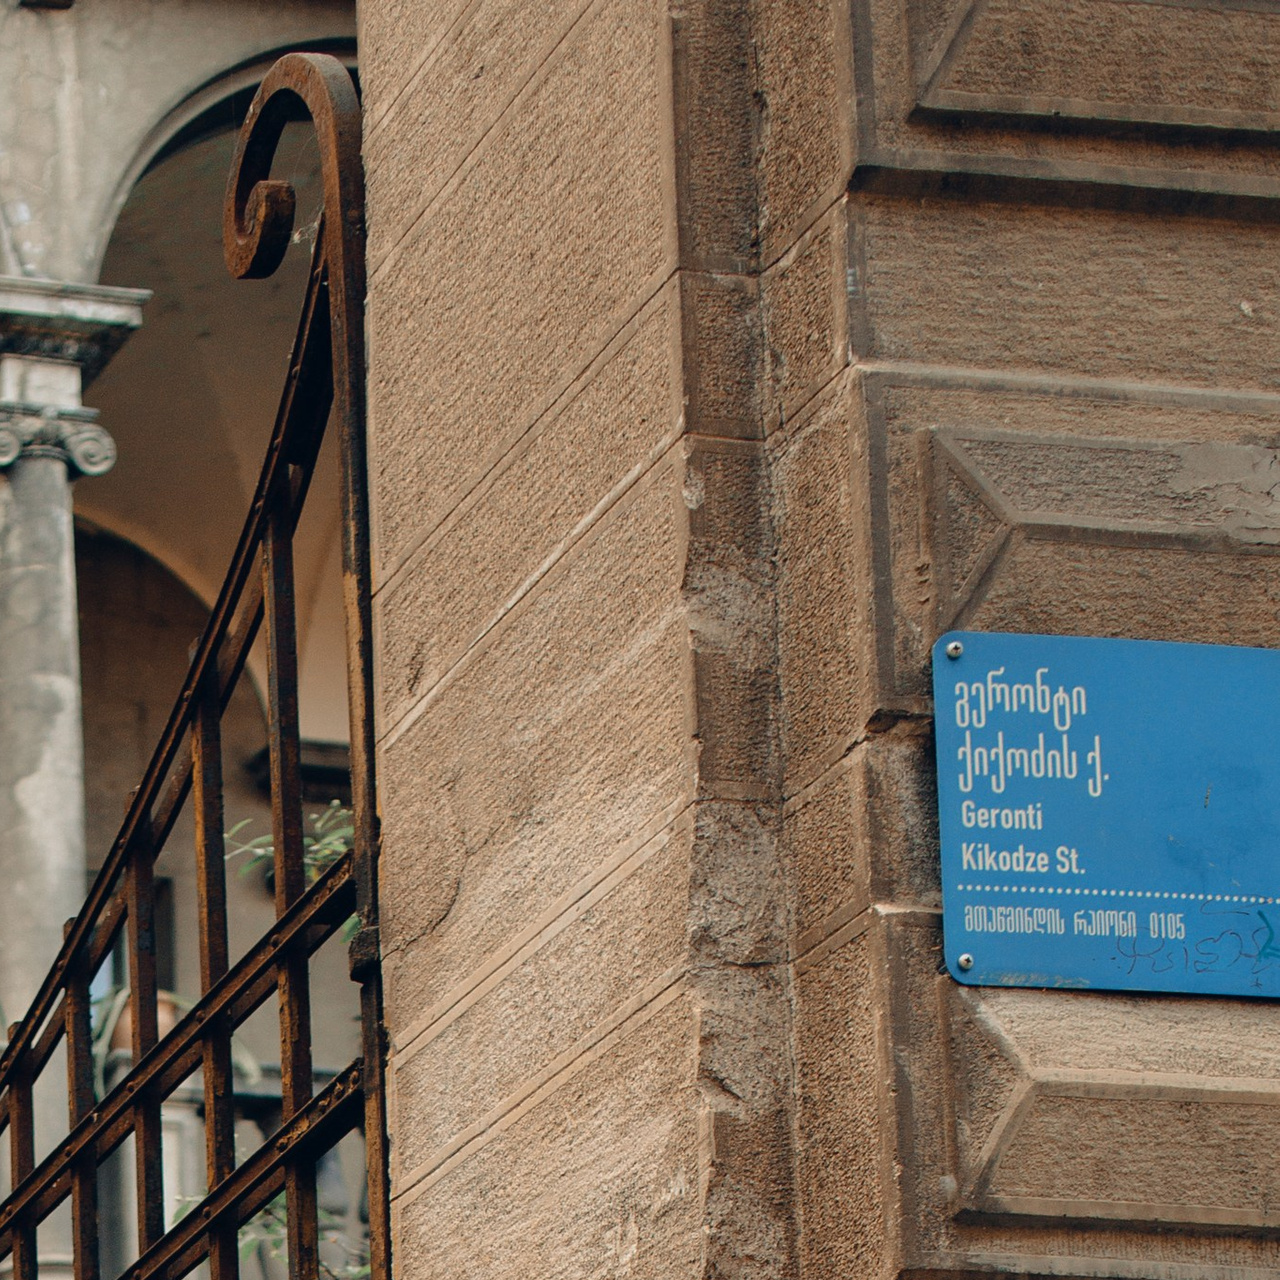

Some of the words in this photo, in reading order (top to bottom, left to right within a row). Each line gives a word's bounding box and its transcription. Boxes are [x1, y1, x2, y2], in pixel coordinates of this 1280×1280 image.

[955, 667, 1087, 731] გერონტი
[957, 730, 1078, 793] ქიქოძის
[1087, 735, 1110, 798] ქ.
[961, 800, 1043, 830] Geronti
[961, 842, 1050, 874] Kikodze
[1056, 846, 1086, 875] St.
[964, 905, 1066, 935] მთაწმინდის
[1074, 909, 1138, 938] რაიონი
[1149, 911, 1186, 940] 0105
